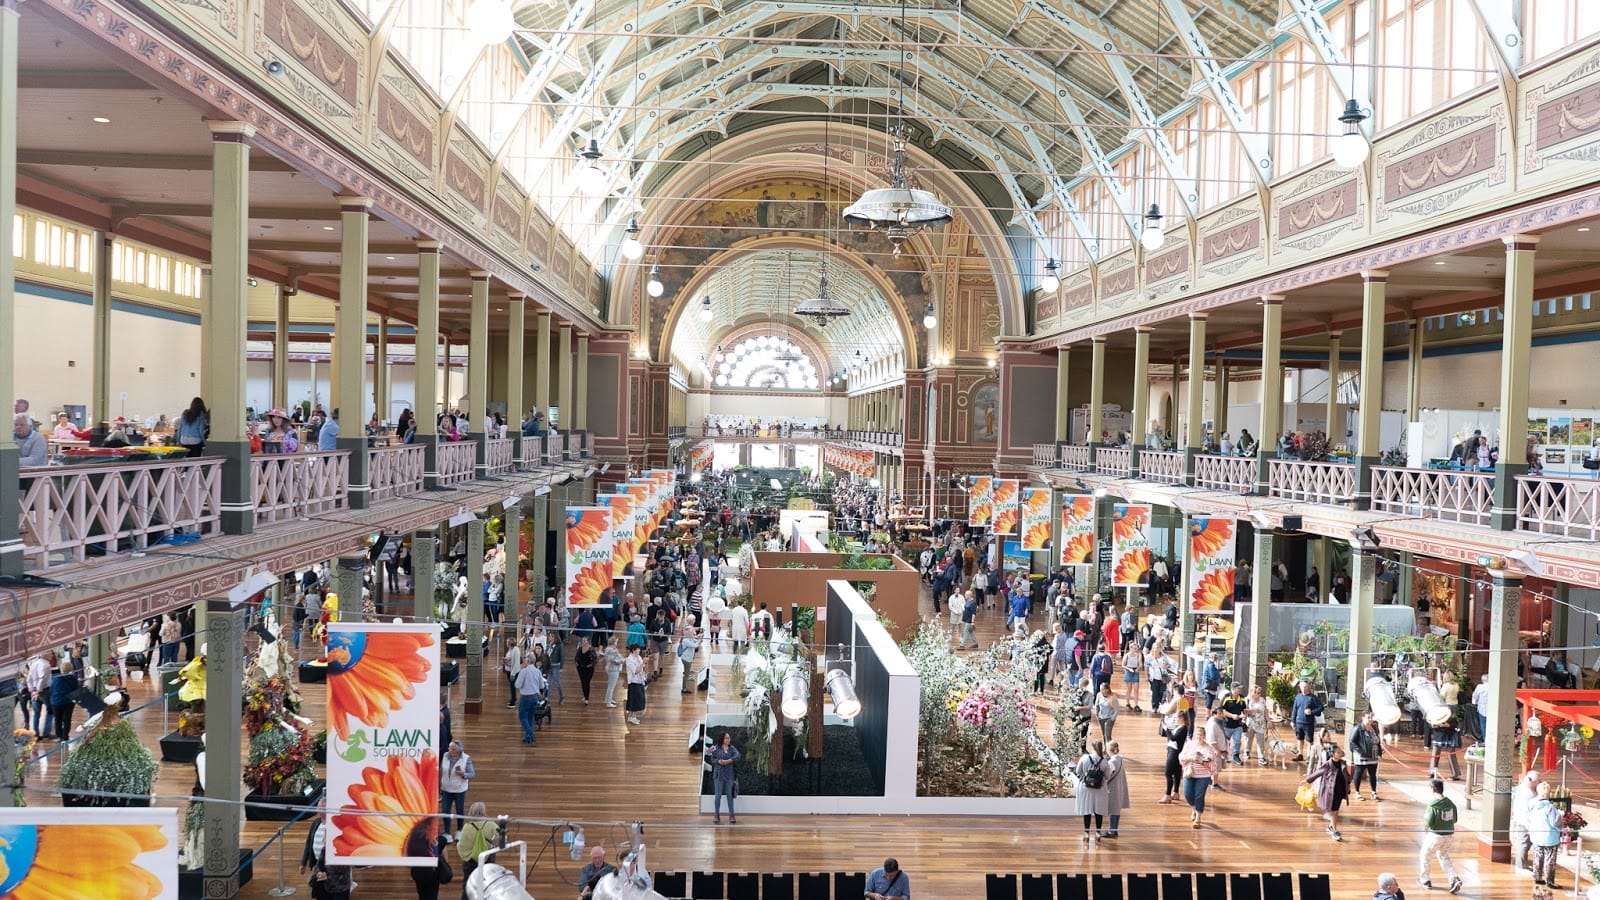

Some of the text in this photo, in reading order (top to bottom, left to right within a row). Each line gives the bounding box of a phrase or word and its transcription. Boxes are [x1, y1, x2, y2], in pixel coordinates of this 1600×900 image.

[612, 530, 633, 538] LAWN
[585, 550, 610, 559] LAWN
[1209, 558, 1233, 566] LAWN
[373, 729, 431, 747] LAWN
[372, 747, 431, 758] SOLUTIONS
